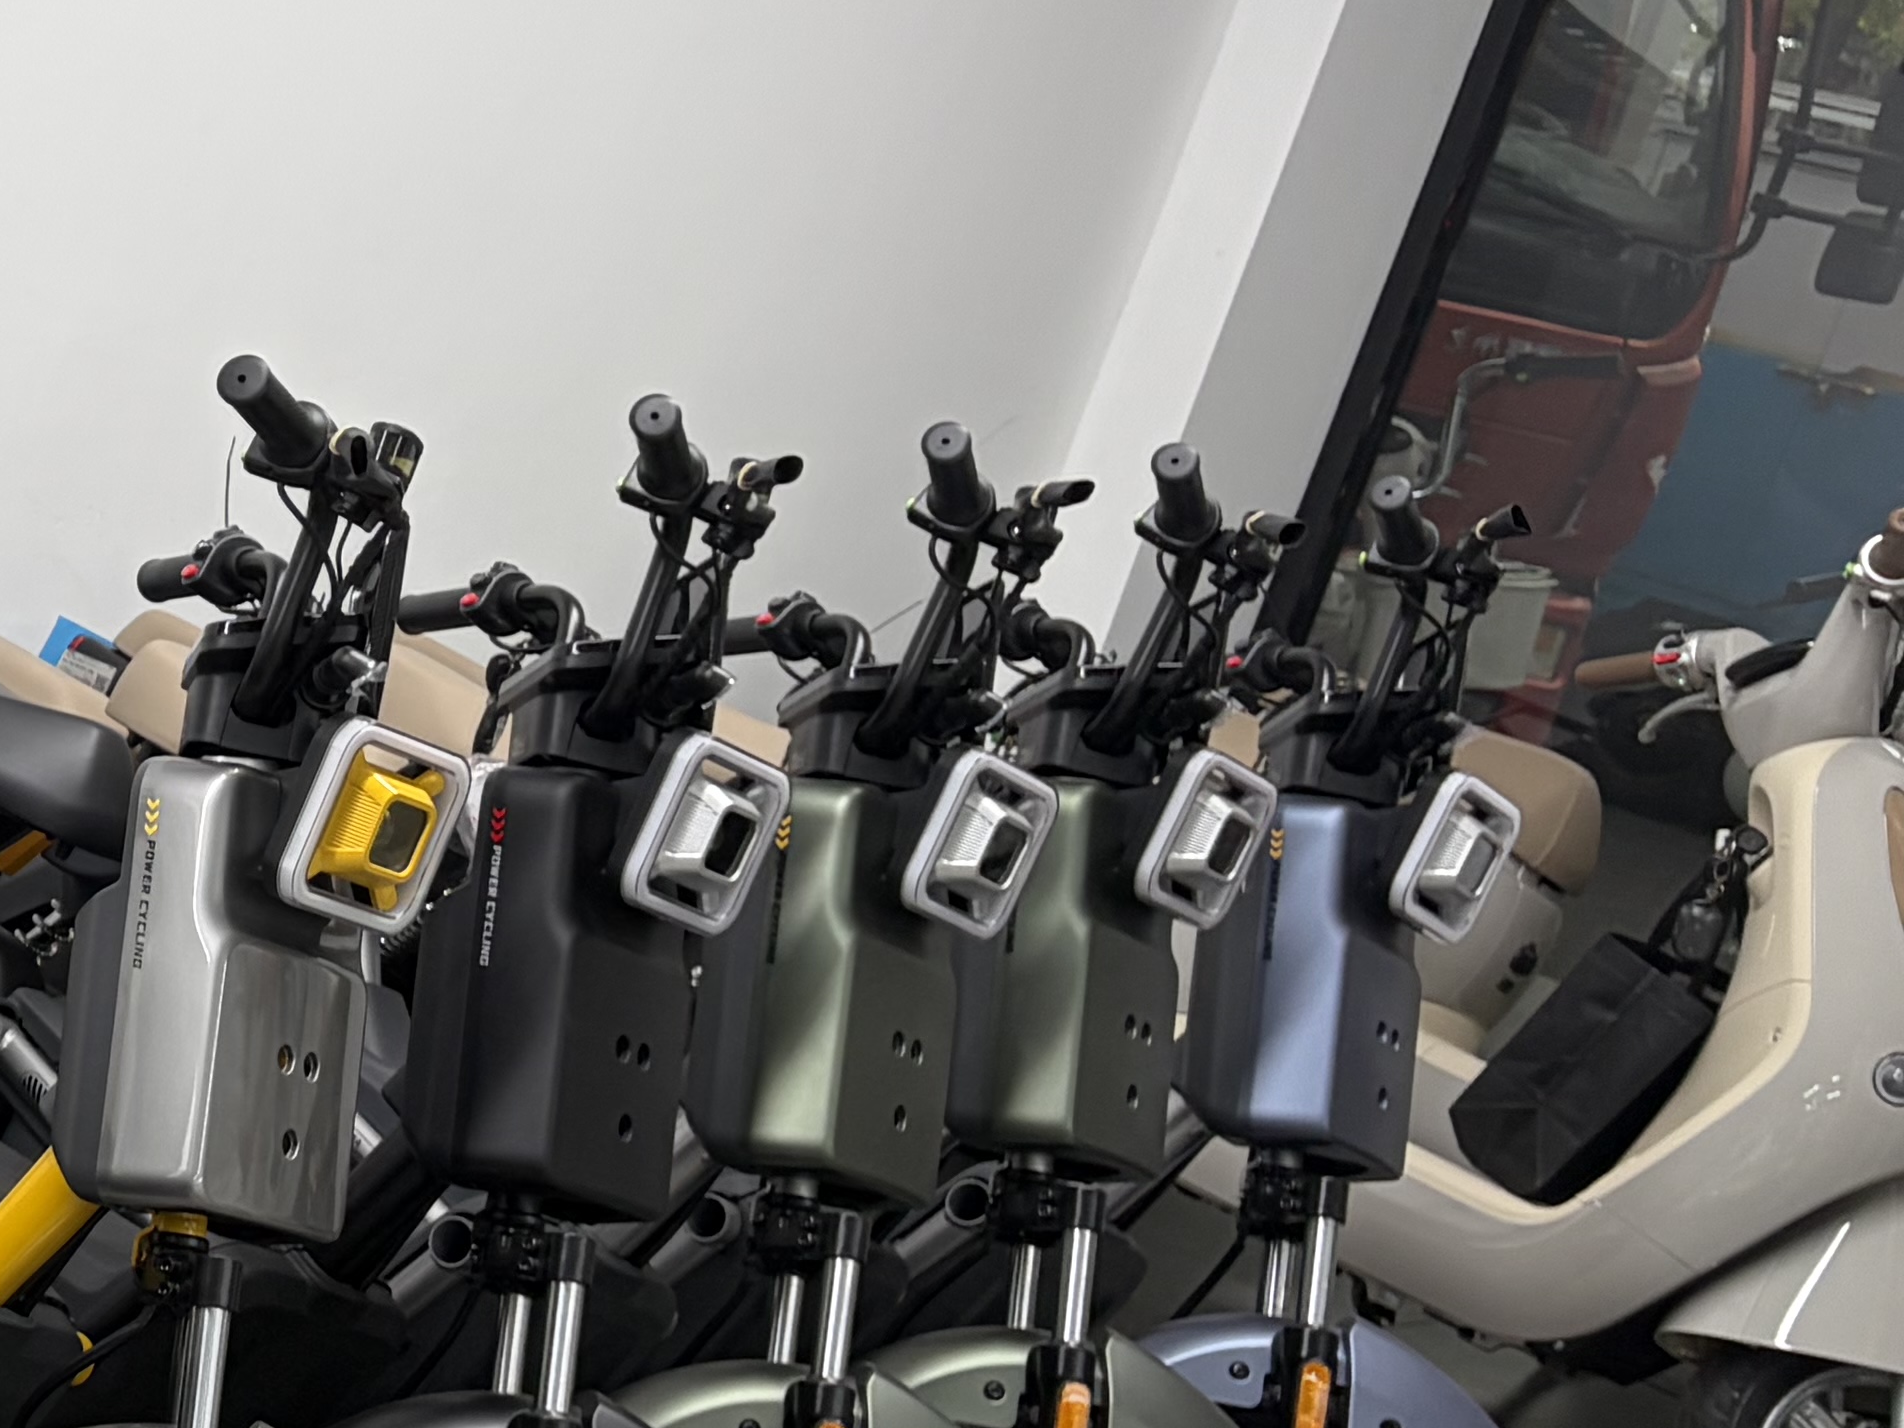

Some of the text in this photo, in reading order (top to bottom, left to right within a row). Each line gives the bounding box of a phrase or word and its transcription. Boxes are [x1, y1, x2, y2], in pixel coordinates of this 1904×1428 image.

[133, 839, 156, 970] POWER CYCLING
[479, 844, 502, 967] POWER CYCLING
